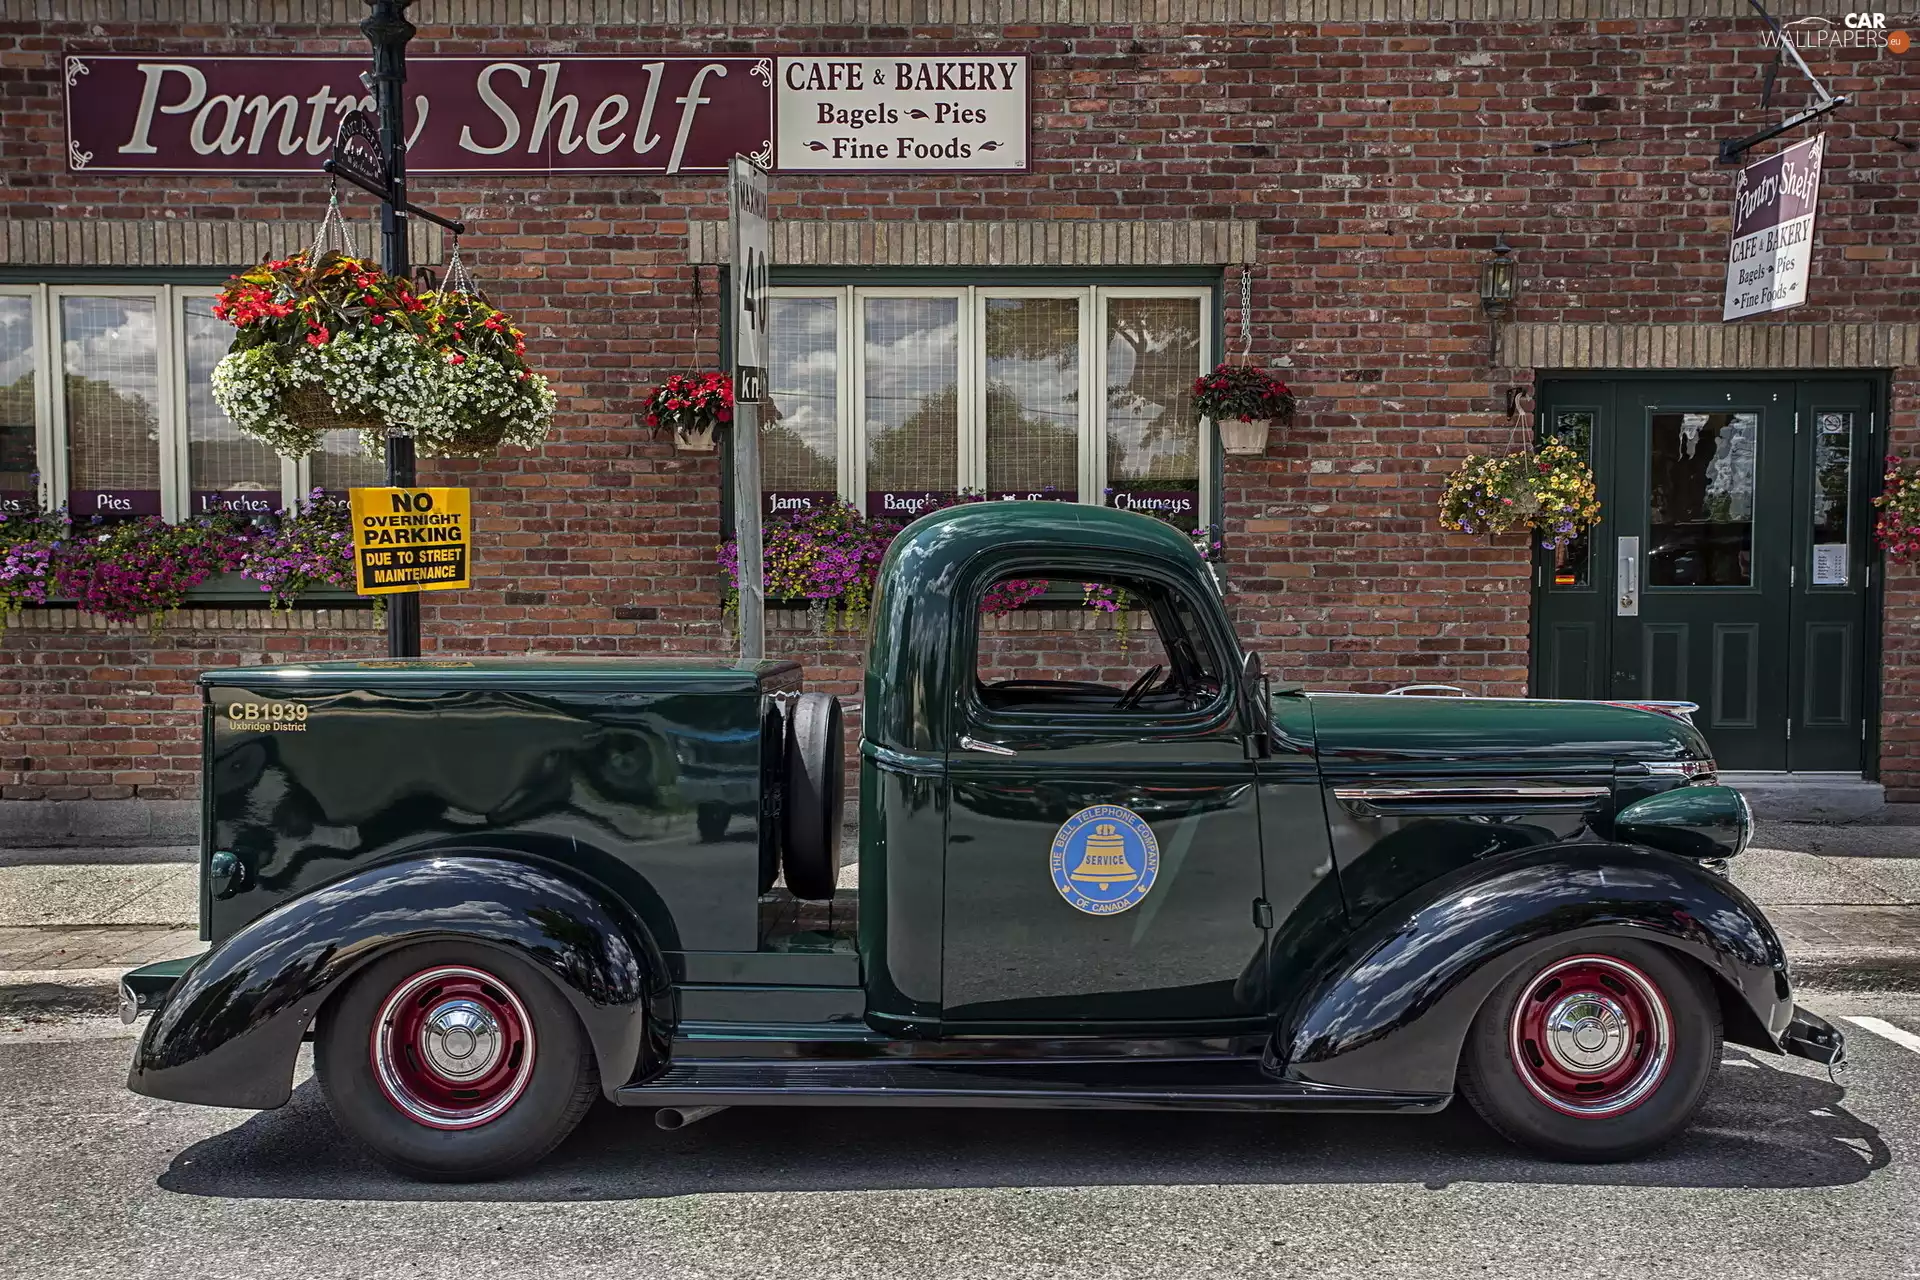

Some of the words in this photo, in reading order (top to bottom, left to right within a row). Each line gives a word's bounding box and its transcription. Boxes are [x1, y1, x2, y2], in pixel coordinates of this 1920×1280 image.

[785, 62, 864, 91] CAFE
[873, 68, 885, 86] &
[895, 62, 1018, 91] BAKERY
[458, 62, 728, 175] Shelf
[817, 102, 898, 129] Bagels
[934, 102, 987, 124] Pies
[832, 137, 888, 159] Fine
[896, 137, 972, 159] Foods
[1736, 174, 1778, 232] Pantry
[1779, 162, 1816, 209] Shelf
[1732, 236, 1758, 263] CAFE
[1766, 219, 1811, 254] BAKERY
[1738, 264, 1765, 286] Bagels
[1776, 257, 1795, 275] Pies
[744, 246, 766, 335] 40
[1740, 292, 1759, 310] Fine
[1760, 285, 1787, 305] Foods
[97, 494, 132, 510] Pies
[391, 493, 434, 513] NO
[769, 493, 811, 513] Jams
[363, 514, 461, 527] OVERNIGHT
[363, 526, 462, 545] PARKING
[366, 552, 392, 566] DUE
[397, 551, 414, 564] TO
[420, 548, 462, 563] STREET
[374, 565, 456, 583] MAINTENANCE
[228, 702, 308, 721] CB1939
[229, 721, 271, 733] Uxbridge
[273, 722, 307, 732] District
[1075, 807, 1137, 825] TELEPHONE
[1056, 824, 1077, 848] BELL
[1136, 823, 1157, 874] COMPANY
[1053, 851, 1062, 873] THE
[1086, 855, 1124, 865] SERVICE
[1076, 898, 1090, 909] OF
[1092, 899, 1131, 912] CANADA
